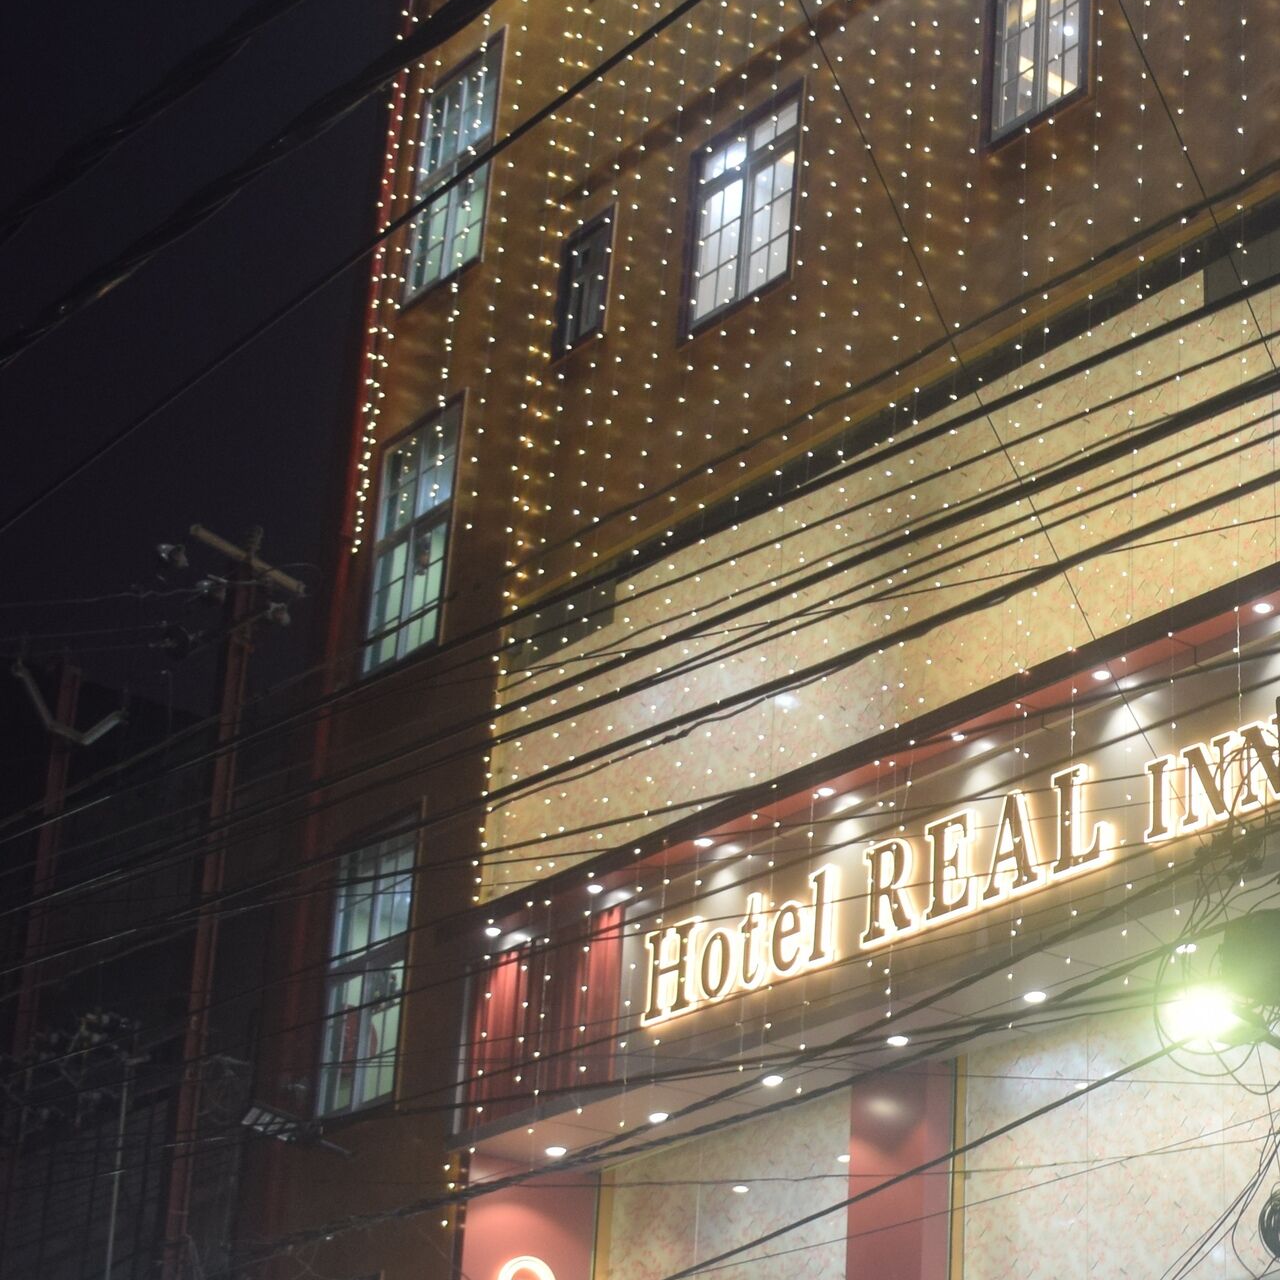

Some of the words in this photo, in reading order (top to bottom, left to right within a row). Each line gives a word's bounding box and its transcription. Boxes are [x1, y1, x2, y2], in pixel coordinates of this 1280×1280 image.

[641, 863, 838, 1027] Hotel
[858, 763, 1114, 950] REAL
[1144, 714, 1280, 843] INN
